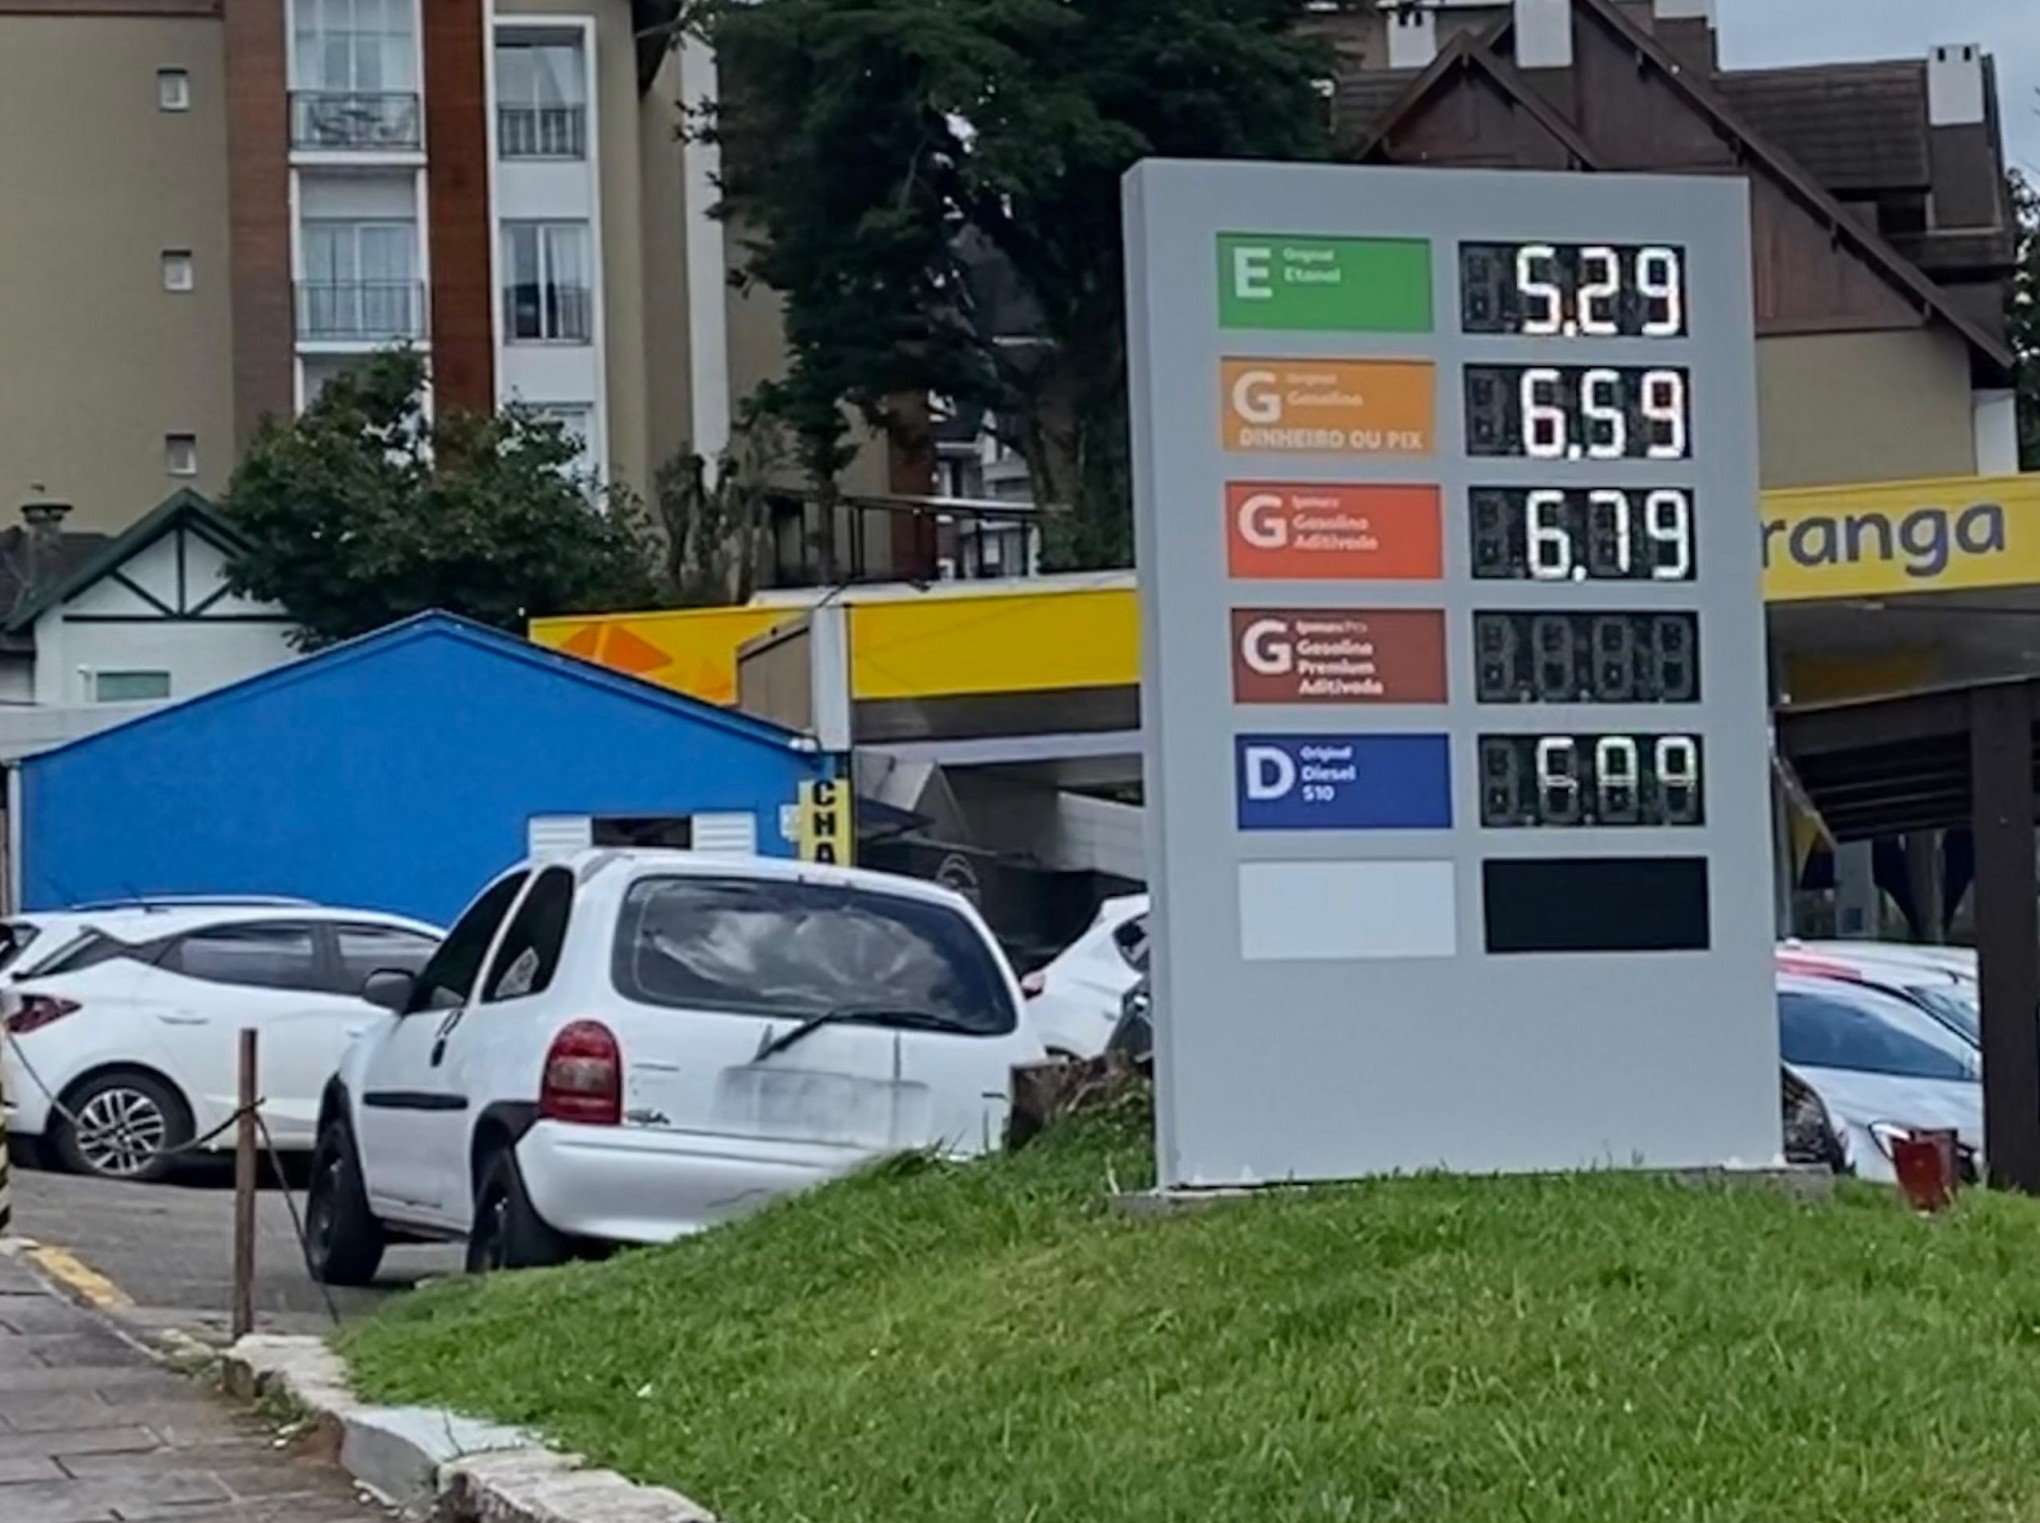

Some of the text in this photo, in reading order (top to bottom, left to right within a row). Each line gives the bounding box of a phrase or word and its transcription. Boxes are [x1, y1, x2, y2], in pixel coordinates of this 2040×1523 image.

[1233, 246, 1273, 299] E
[1516, 245, 1681, 337] 5.29
[1233, 370, 1283, 424] G
[1520, 368, 1687, 461] 6.59
[1240, 428, 1424, 450] DINHEIRO OU PIX
[1238, 494, 1288, 549] G
[1525, 489, 1690, 583] 6.79
[1242, 618, 1293, 676] G
[1295, 638, 1375, 657] Gasolina
[1297, 658, 1377, 676] Premium
[1298, 678, 1385, 696] Aditivada
[1245, 746, 1296, 800] D
[1301, 764, 1357, 782] Diesel
[1302, 784, 1336, 802] S10
